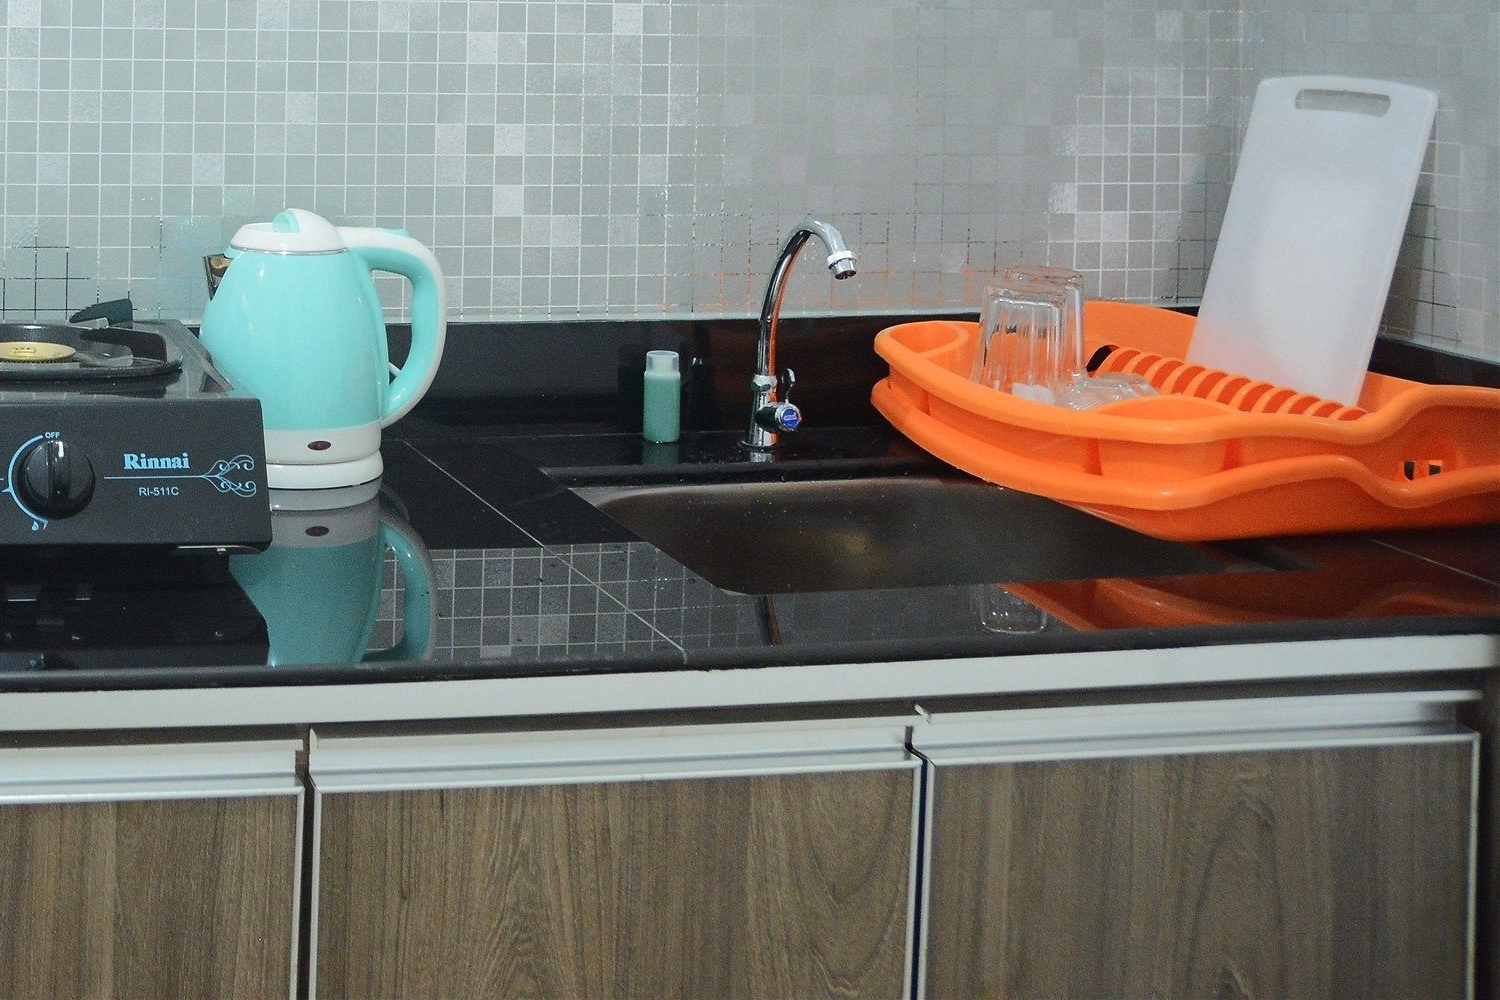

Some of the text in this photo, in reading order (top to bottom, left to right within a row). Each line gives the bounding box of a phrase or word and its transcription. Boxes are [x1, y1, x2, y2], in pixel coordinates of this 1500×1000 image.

[44, 431, 61, 439] OFF
[123, 452, 190, 470] Rinnai
[137, 486, 180, 498] RI-511C
